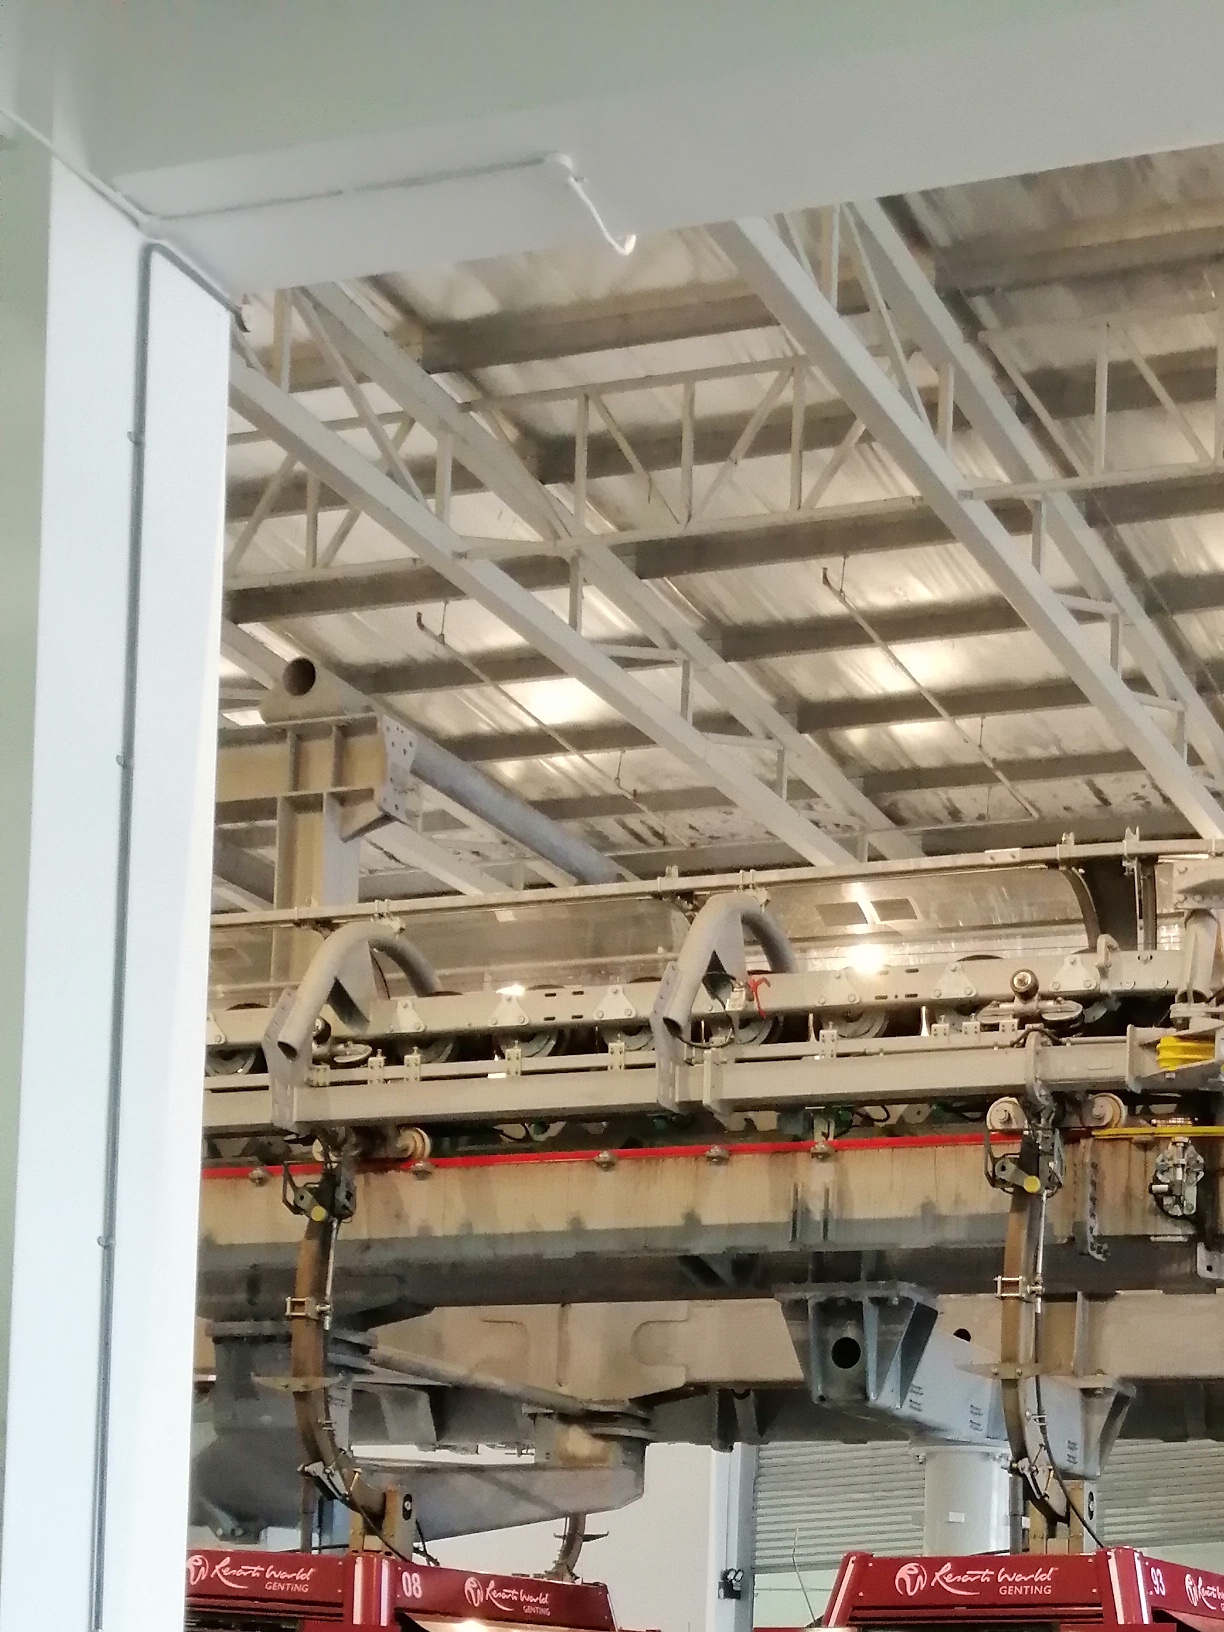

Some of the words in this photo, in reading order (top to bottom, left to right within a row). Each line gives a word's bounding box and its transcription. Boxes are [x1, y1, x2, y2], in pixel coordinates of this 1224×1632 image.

[211, 1557, 264, 1588] Resorts
[264, 1565, 314, 1580] World
[402, 1572, 422, 1598] 08
[931, 1562, 995, 1595] Resorts
[997, 1567, 1052, 1583] World
[1151, 1567, 1166, 1595] 93
[265, 1582, 309, 1592] GENTING
[1000, 1585, 1052, 1596] GENTING
